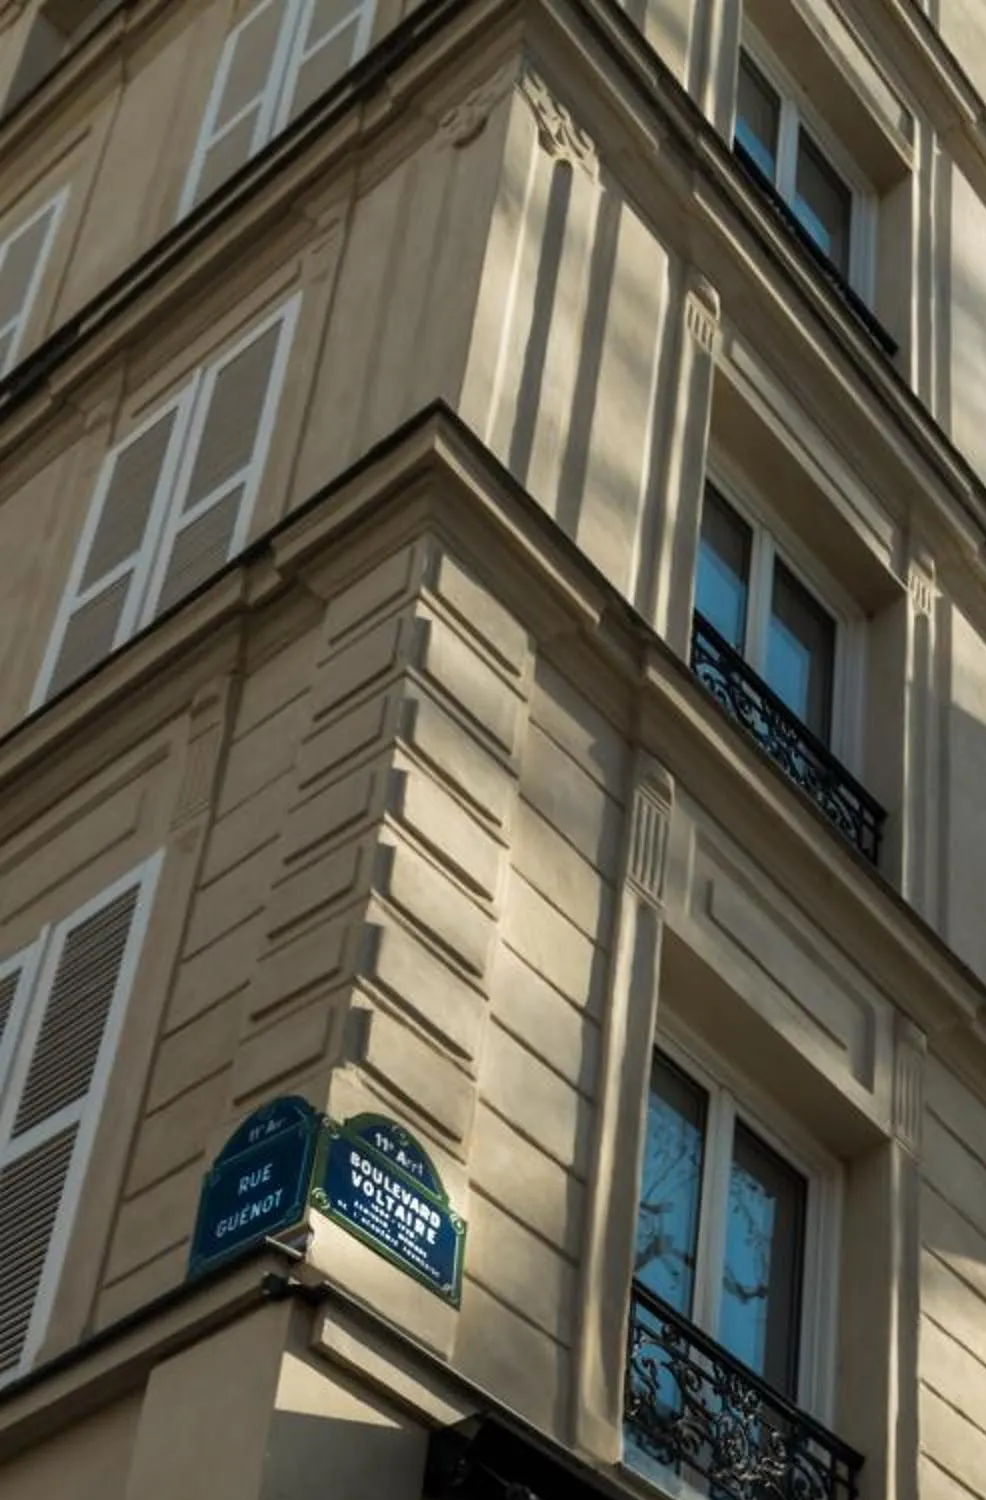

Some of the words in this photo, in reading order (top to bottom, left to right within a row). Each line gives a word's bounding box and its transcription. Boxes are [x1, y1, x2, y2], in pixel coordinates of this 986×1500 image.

[238, 1163, 273, 1196] RUE
[350, 1152, 441, 1229] BOULEVARD
[351, 1170, 437, 1245] VOLTAIRE
